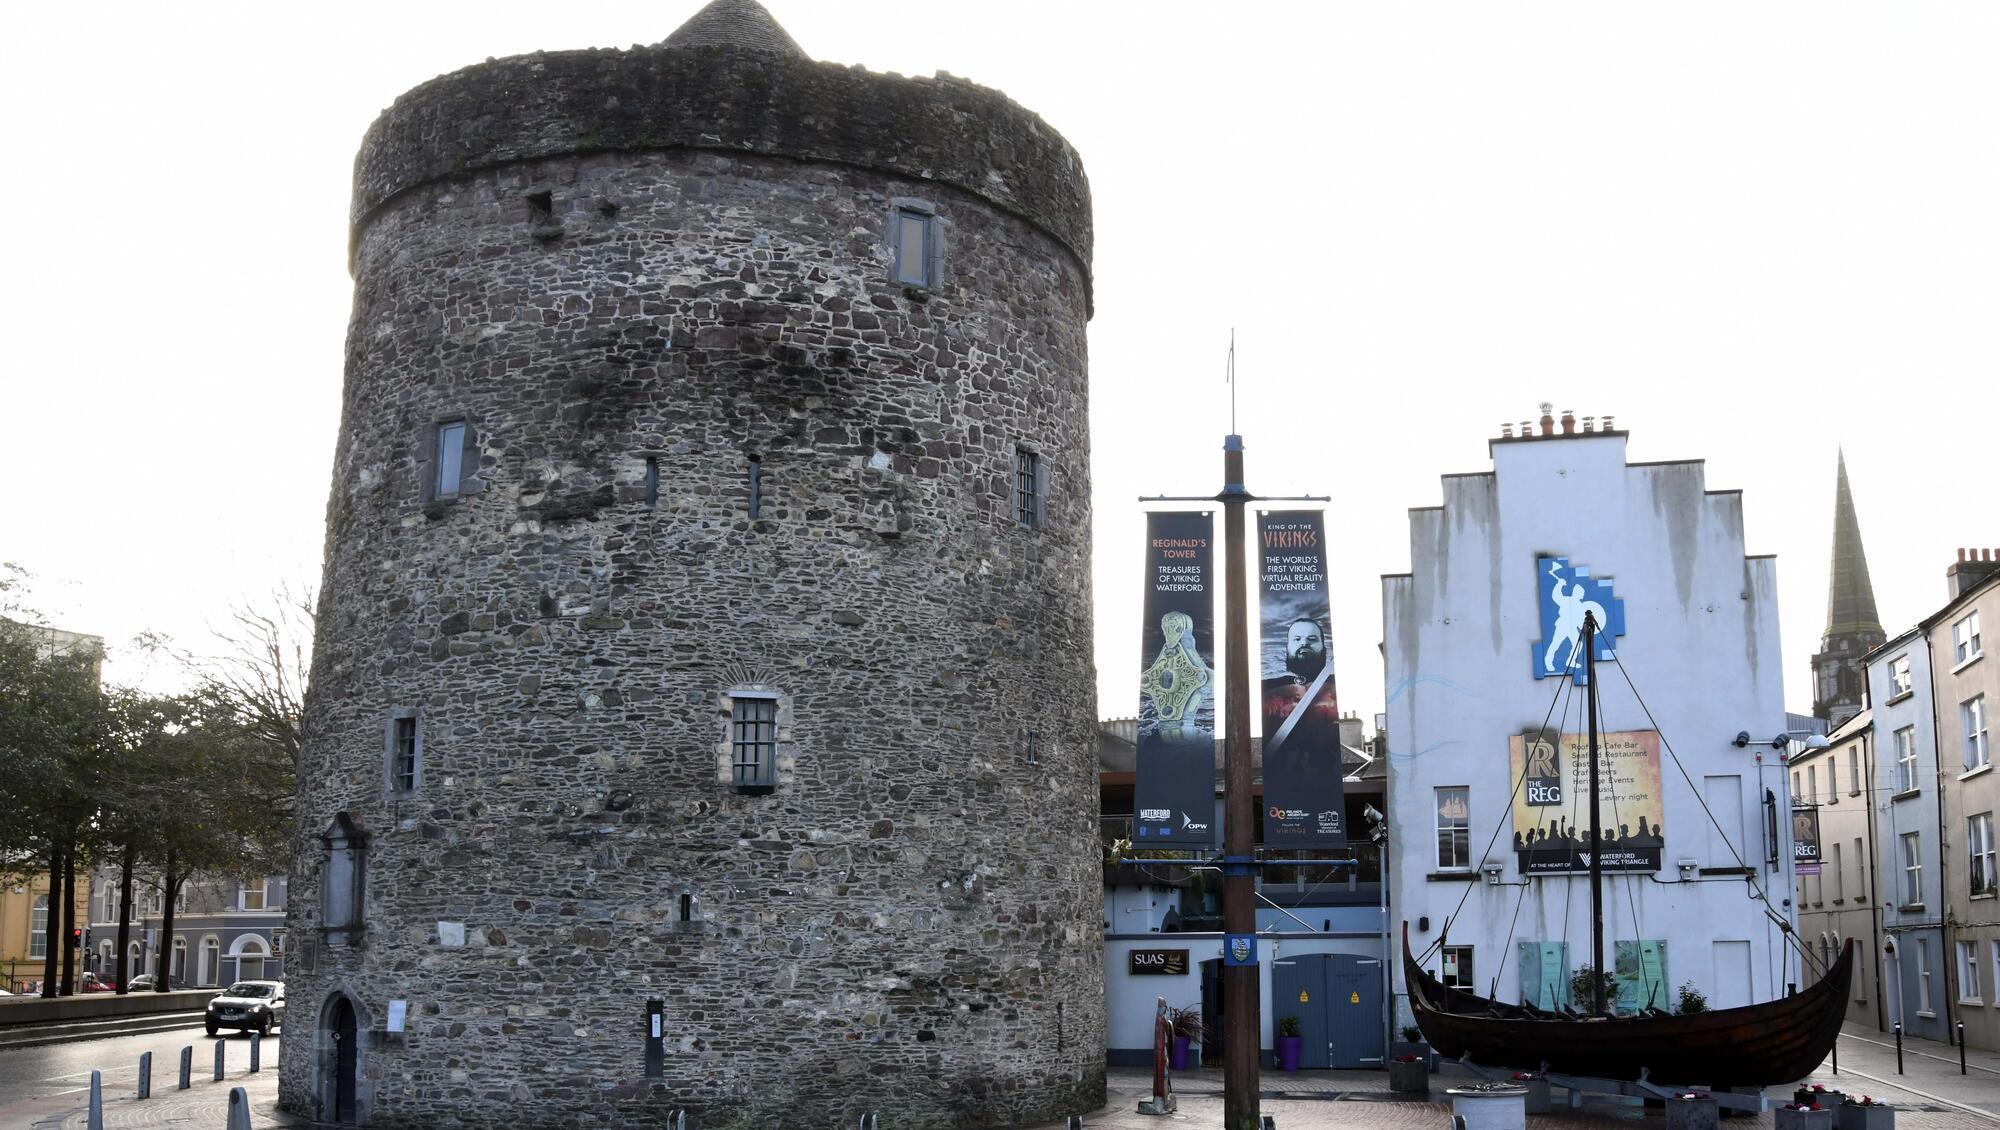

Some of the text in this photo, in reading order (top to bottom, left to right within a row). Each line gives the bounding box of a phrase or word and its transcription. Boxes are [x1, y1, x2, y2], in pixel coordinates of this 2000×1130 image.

[1152, 539, 1206, 548] REGINALD'S
[1264, 531, 1317, 548] VIKINGS
[1163, 550, 1196, 559] TOWER
[1528, 787, 1560, 802] REG
[1140, 809, 1170, 817] WATERFORD
[1795, 846, 1816, 856] REG
[1135, 954, 1165, 964] SUAS
